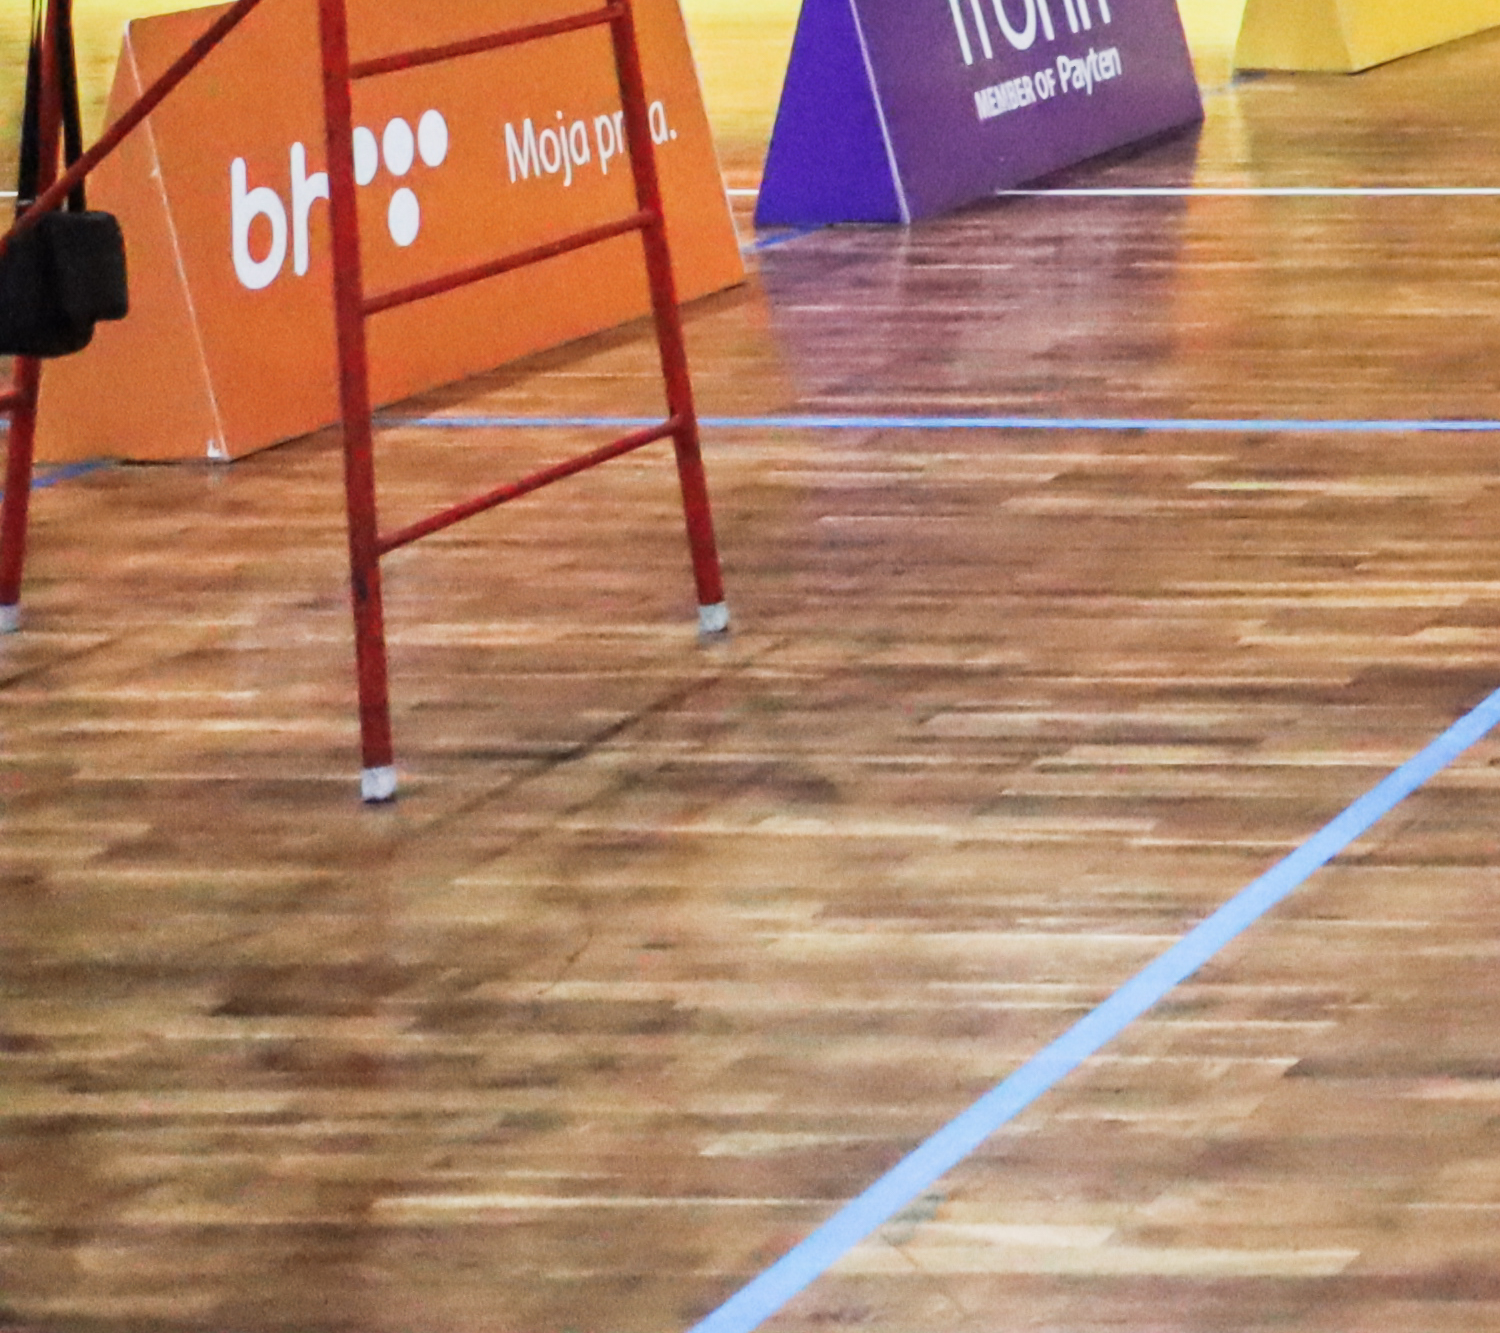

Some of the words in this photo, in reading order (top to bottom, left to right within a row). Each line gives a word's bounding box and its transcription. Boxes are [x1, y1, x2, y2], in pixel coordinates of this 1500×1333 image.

[974, 75, 1037, 121] MEMBER
[1034, 68, 1056, 100] OF
[1056, 46, 1123, 95] Payten
[504, 110, 590, 187] Moja
[594, 100, 678, 175] pra.
